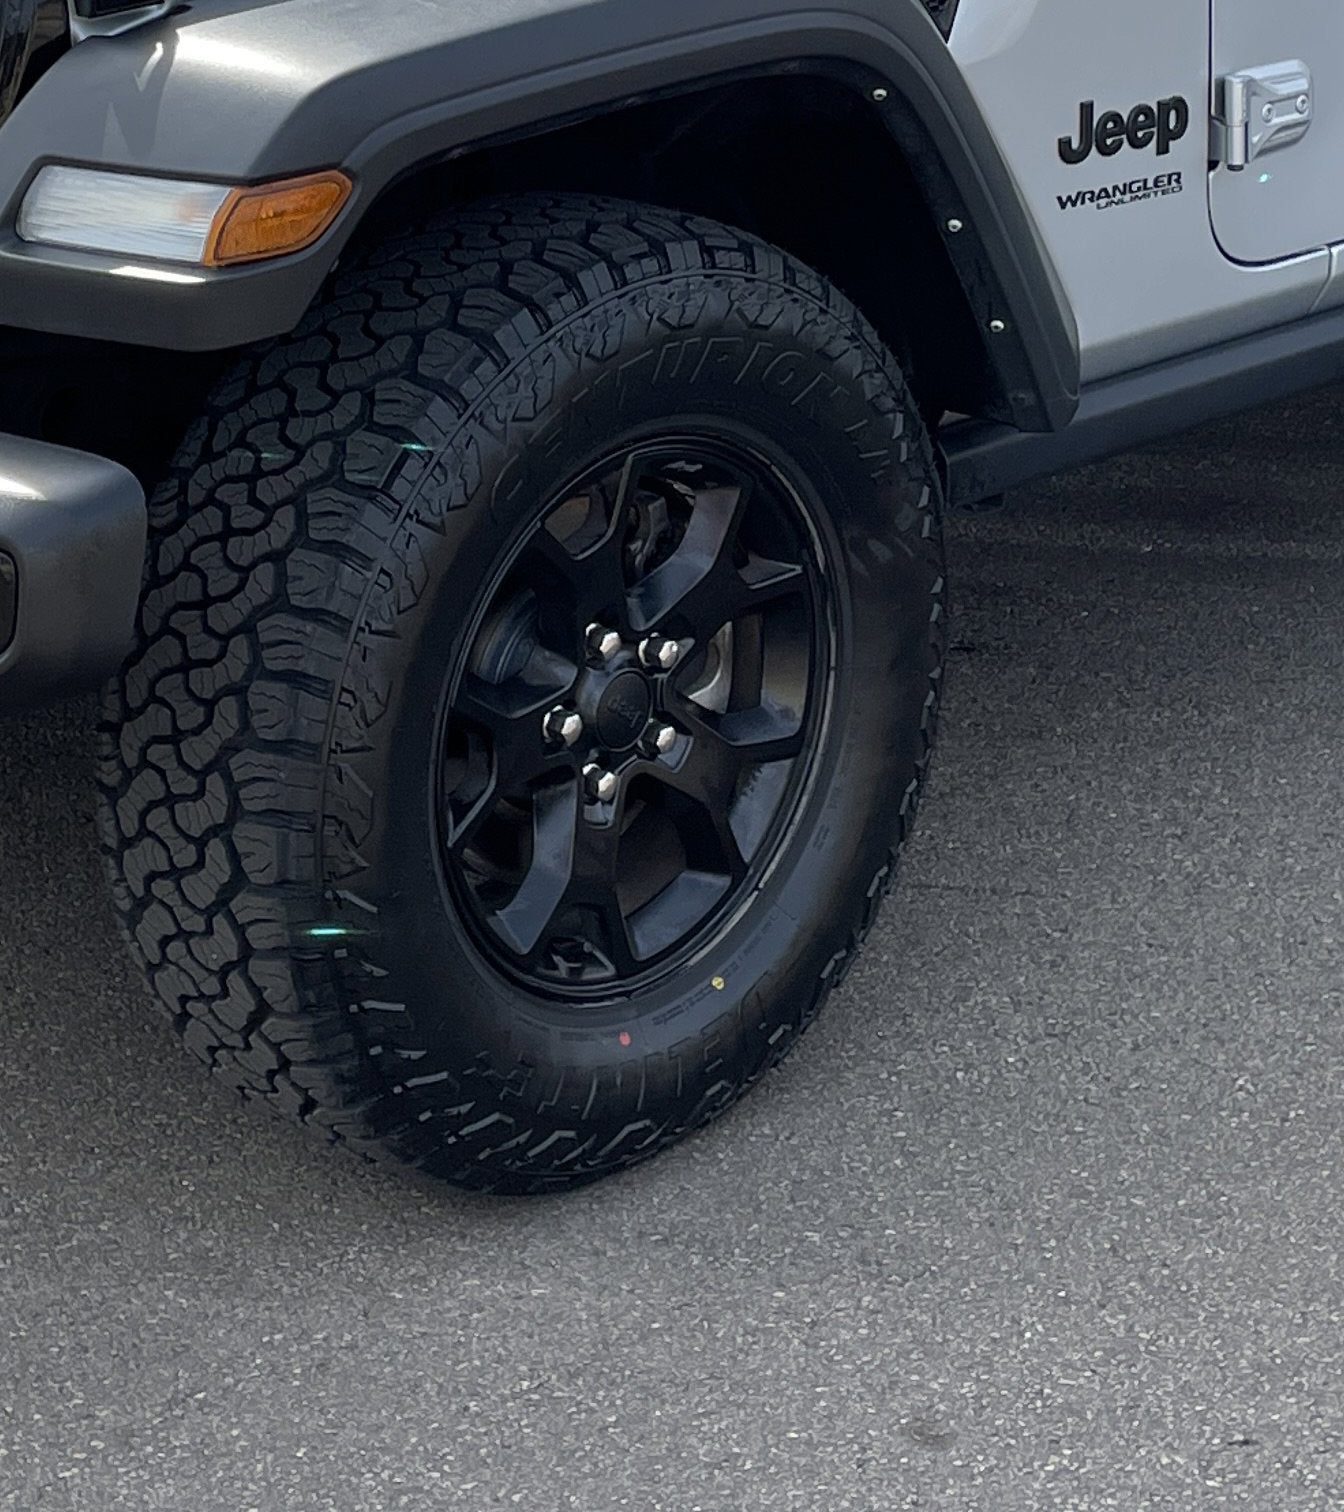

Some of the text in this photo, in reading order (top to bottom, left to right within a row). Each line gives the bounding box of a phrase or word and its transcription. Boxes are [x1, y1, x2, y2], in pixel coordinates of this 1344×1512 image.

[1057, 96, 1189, 165] Jeep
[1056, 171, 1183, 210] WRANGLER
[1096, 185, 1184, 210] UNLIMITED
